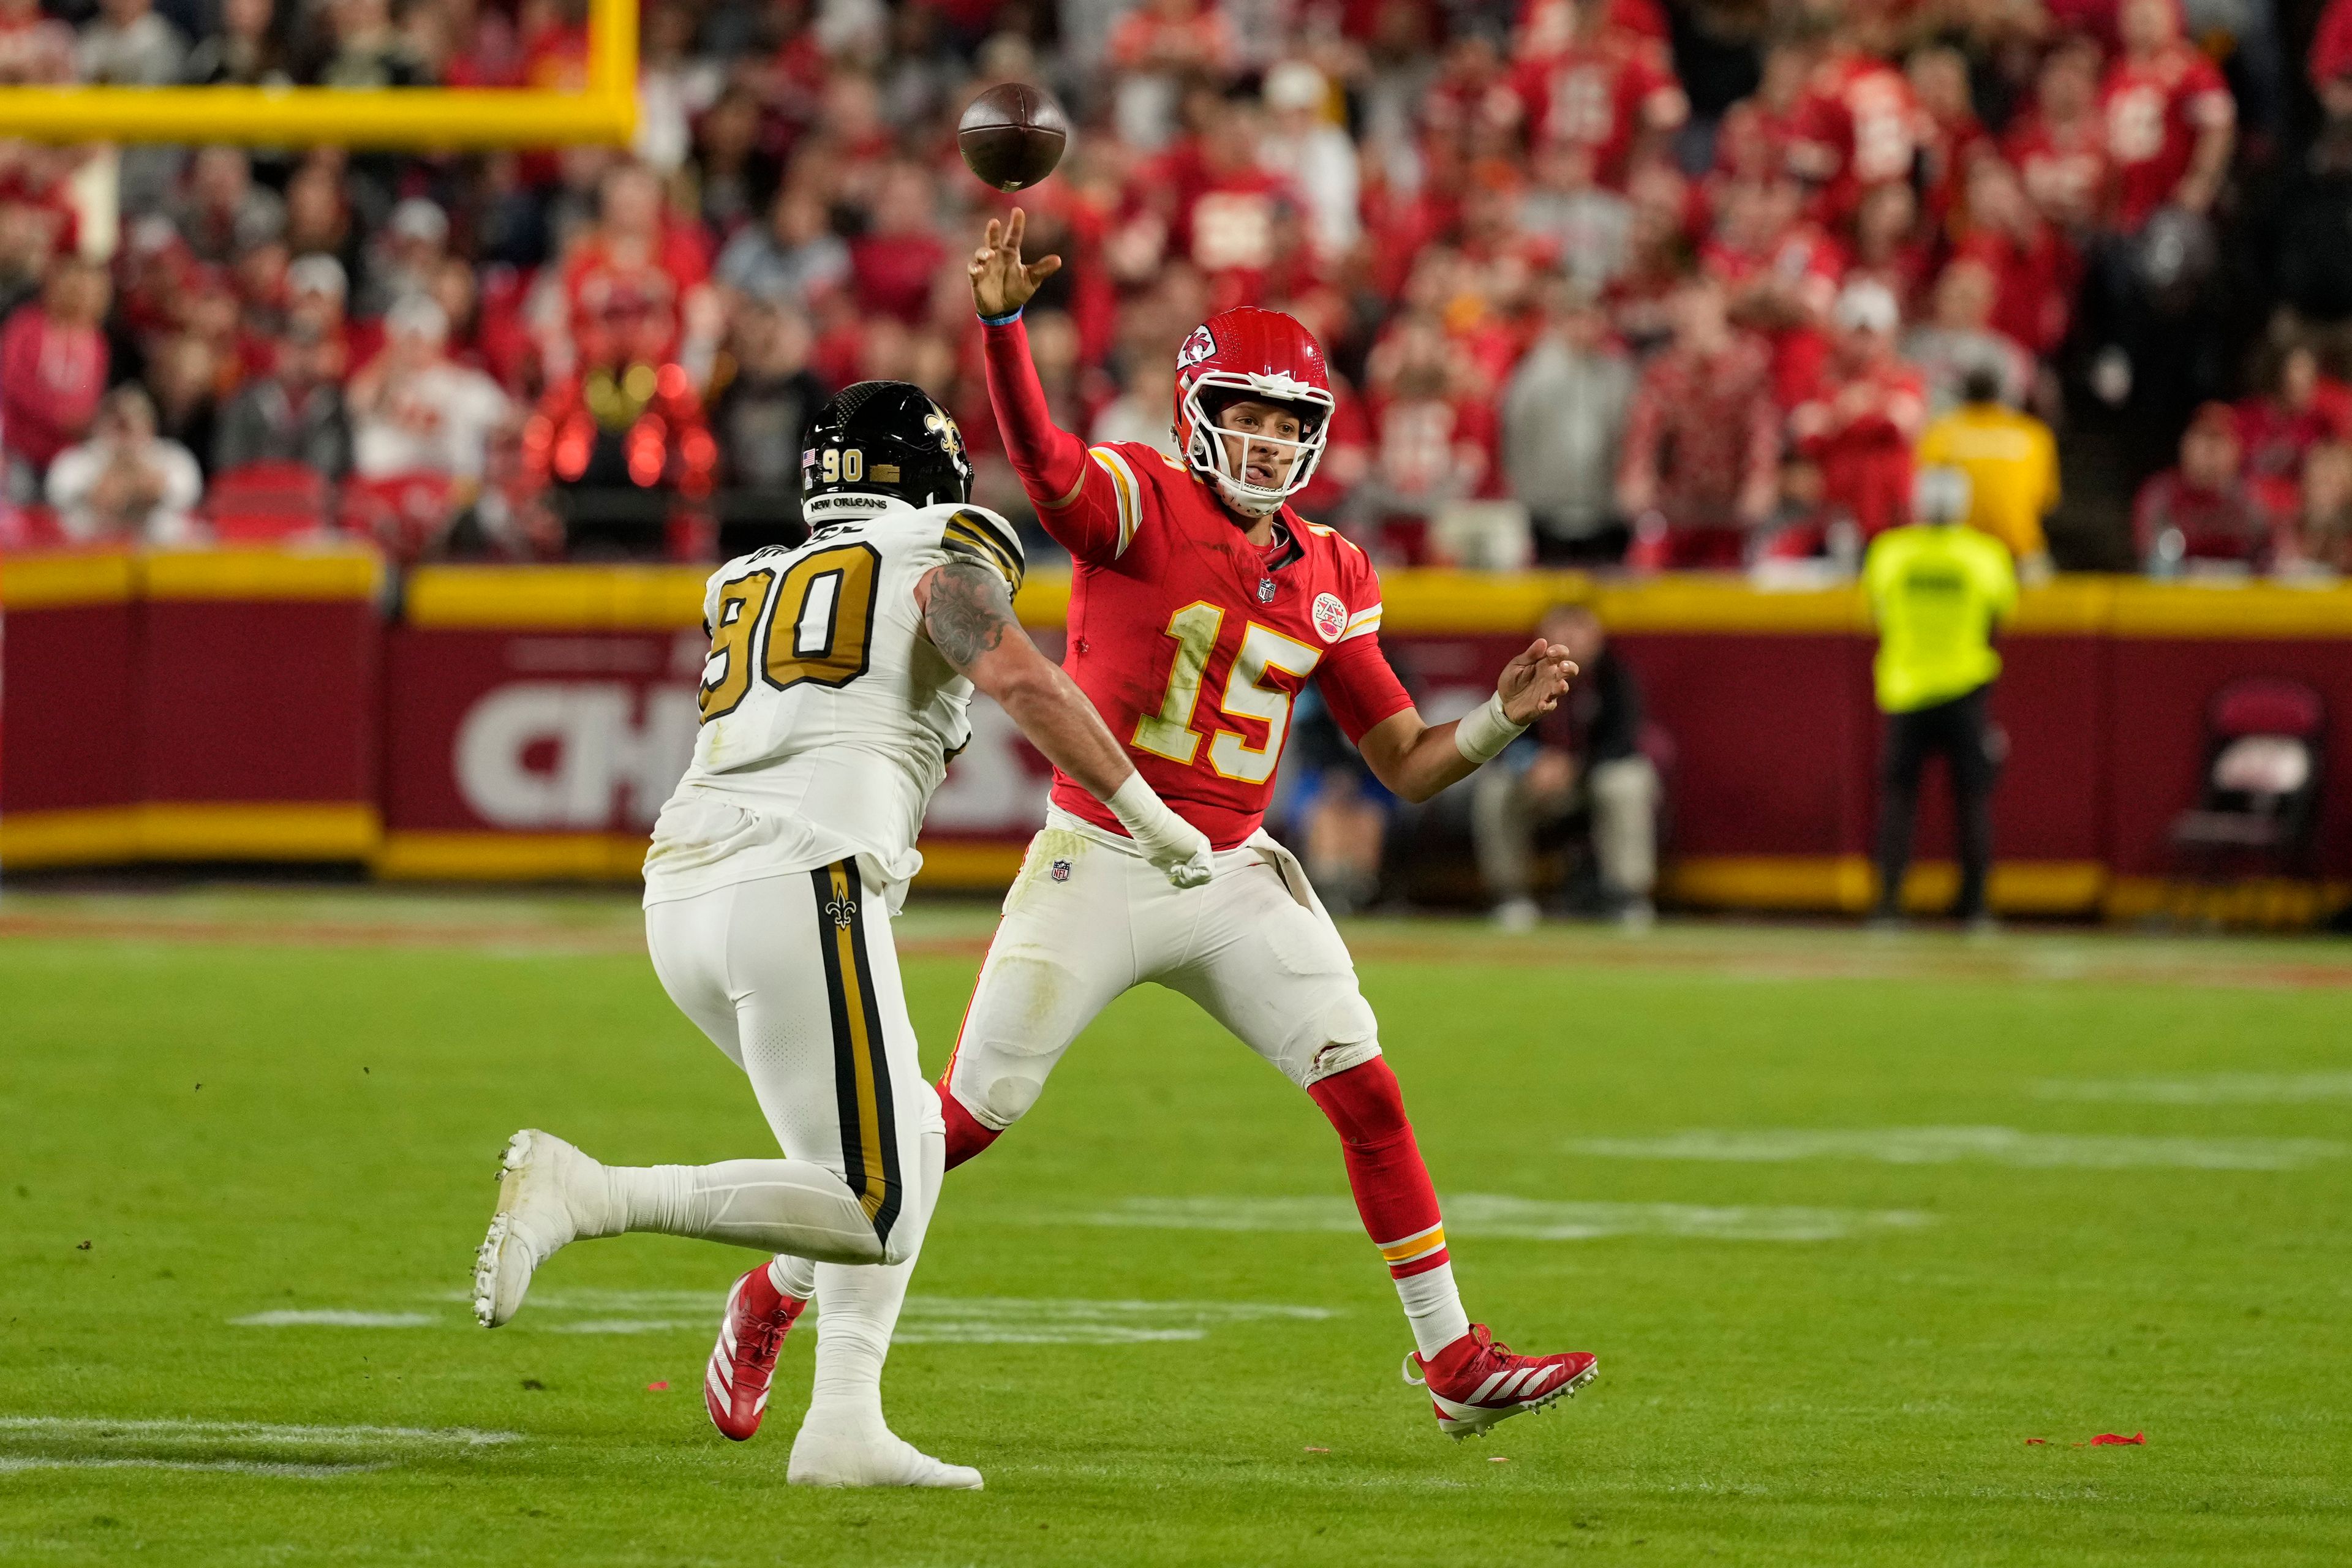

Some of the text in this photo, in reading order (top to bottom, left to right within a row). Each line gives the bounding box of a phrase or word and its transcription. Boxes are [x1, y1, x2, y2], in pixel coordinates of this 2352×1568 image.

[823, 448, 863, 483] 90
[810, 497, 887, 512] NEW ORLEANS
[698, 540, 883, 728] 90
[1129, 599, 1324, 779] 15
[1053, 869, 1068, 879] NFL
